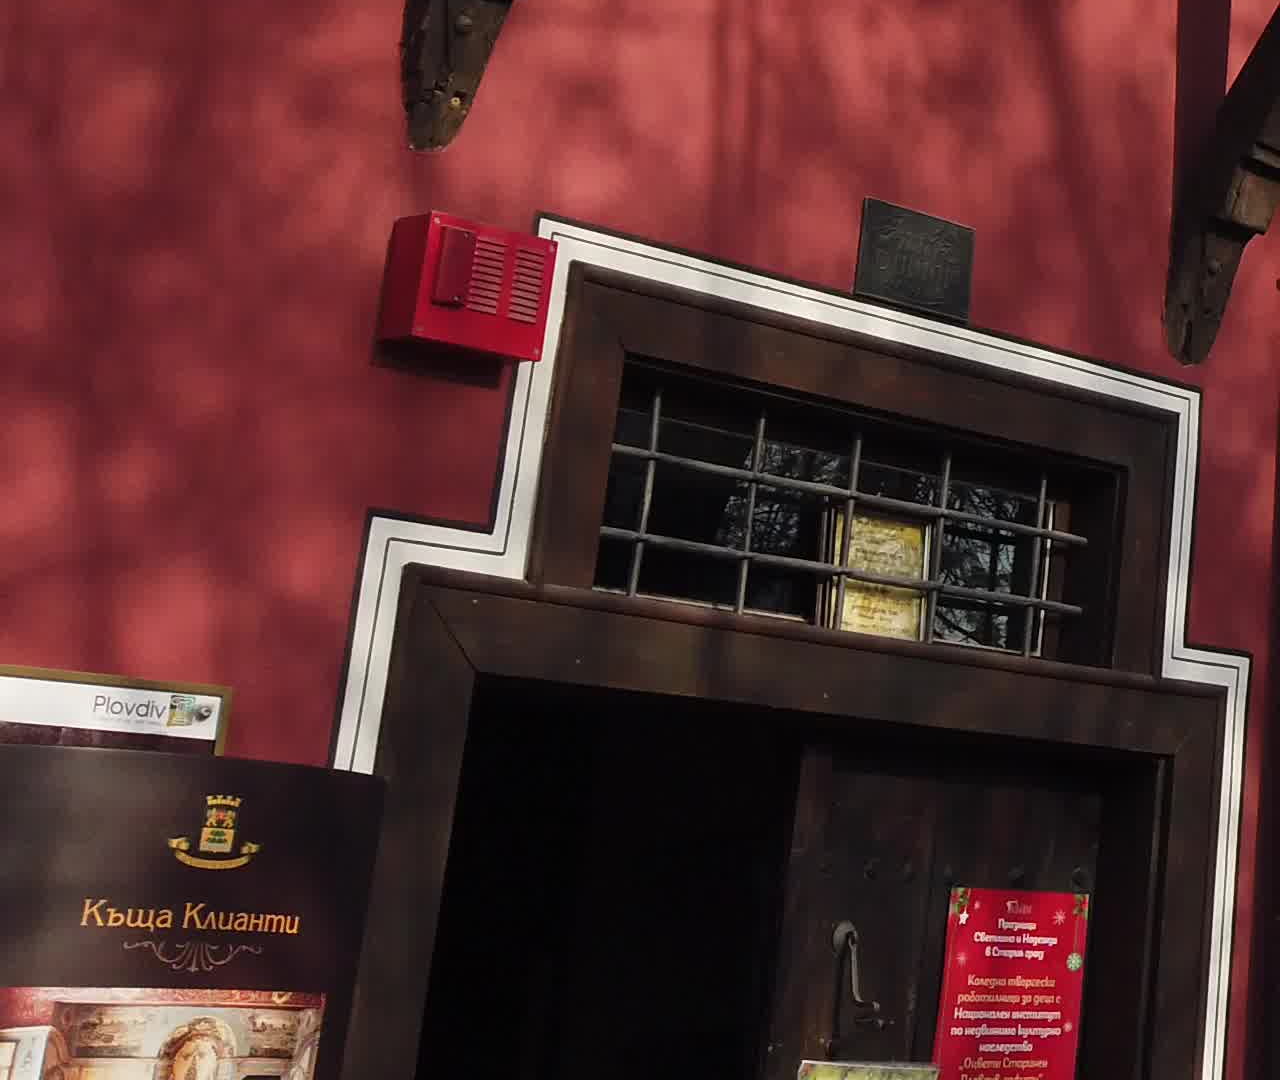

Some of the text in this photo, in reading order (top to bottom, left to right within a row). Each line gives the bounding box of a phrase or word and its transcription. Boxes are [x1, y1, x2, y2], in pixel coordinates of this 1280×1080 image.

[93, 695, 166, 719] Plovdiv
[80, 898, 300, 934] Къща Клианти
[950, 1026, 964, 1036] по
